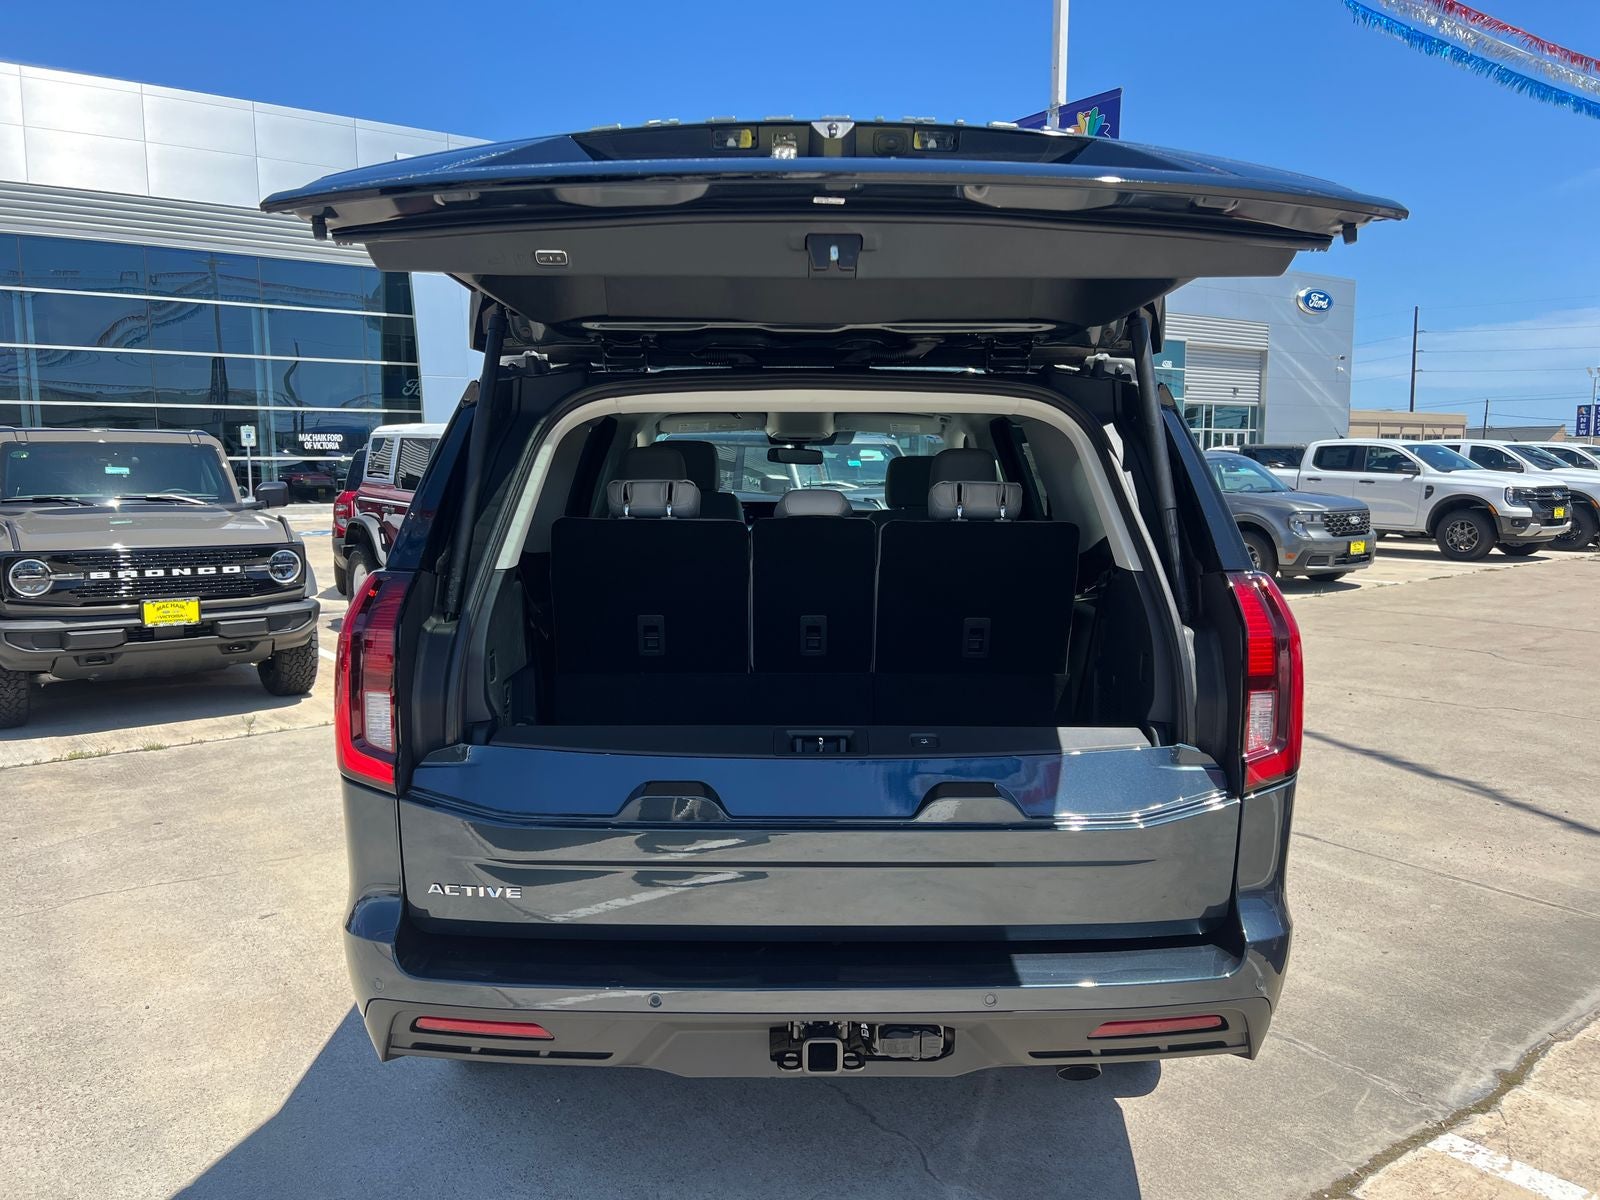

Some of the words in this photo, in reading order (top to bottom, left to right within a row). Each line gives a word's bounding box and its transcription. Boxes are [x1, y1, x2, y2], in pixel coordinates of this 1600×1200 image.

[1309, 293, 1329, 308] Ford
[1579, 417, 1587, 436] NEW
[298, 433, 312, 442] MAC
[312, 433, 327, 442] HAIK
[327, 433, 343, 442] FORD
[304, 441, 313, 450] OF
[312, 441, 340, 450] VICTORIA
[89, 565, 241, 580] BRONCO
[427, 882, 522, 899] ACTIVE
